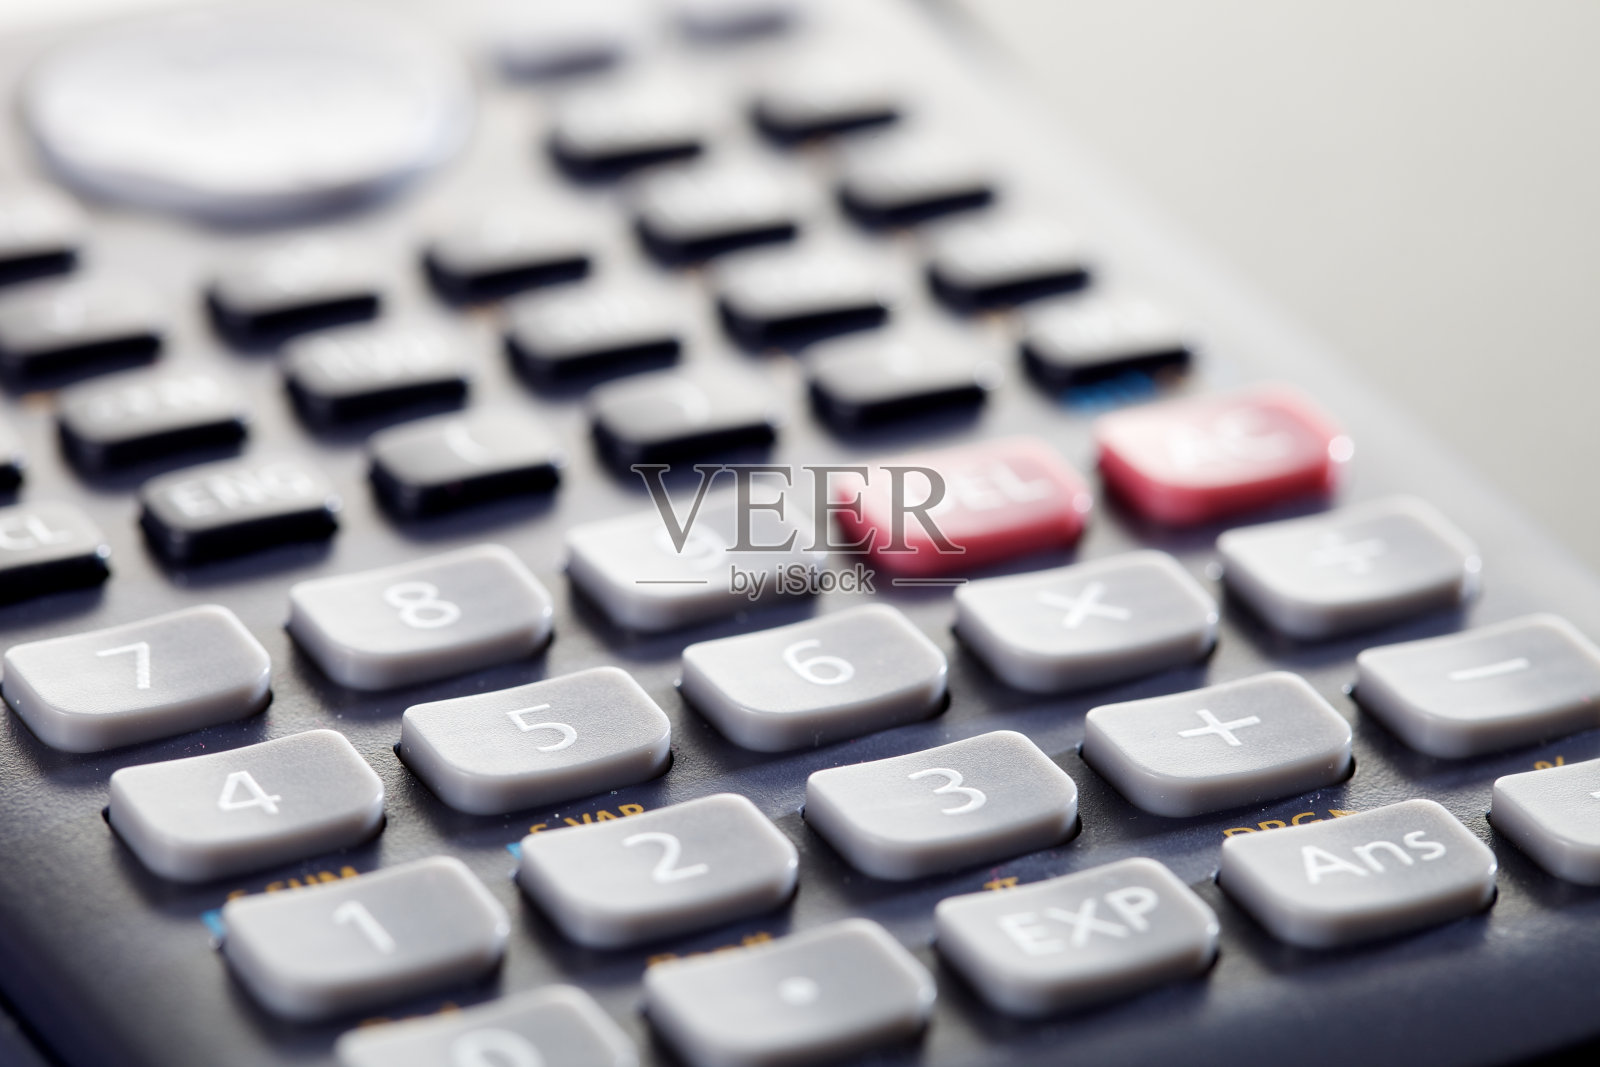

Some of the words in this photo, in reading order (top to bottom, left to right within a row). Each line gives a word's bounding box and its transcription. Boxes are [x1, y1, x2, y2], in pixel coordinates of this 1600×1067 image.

[168, 464, 316, 518] ENG
[385, 581, 462, 629] 8
[95, 641, 151, 690] 7
[782, 639, 855, 686] 6
[506, 703, 578, 754] 5
[217, 770, 282, 815] 4
[908, 767, 988, 816] 3
[622, 831, 710, 885] 2
[1301, 830, 1447, 885] Ans
[331, 899, 397, 955] 1
[997, 886, 1159, 956] EXP
[451, 1028, 545, 1067] 0
